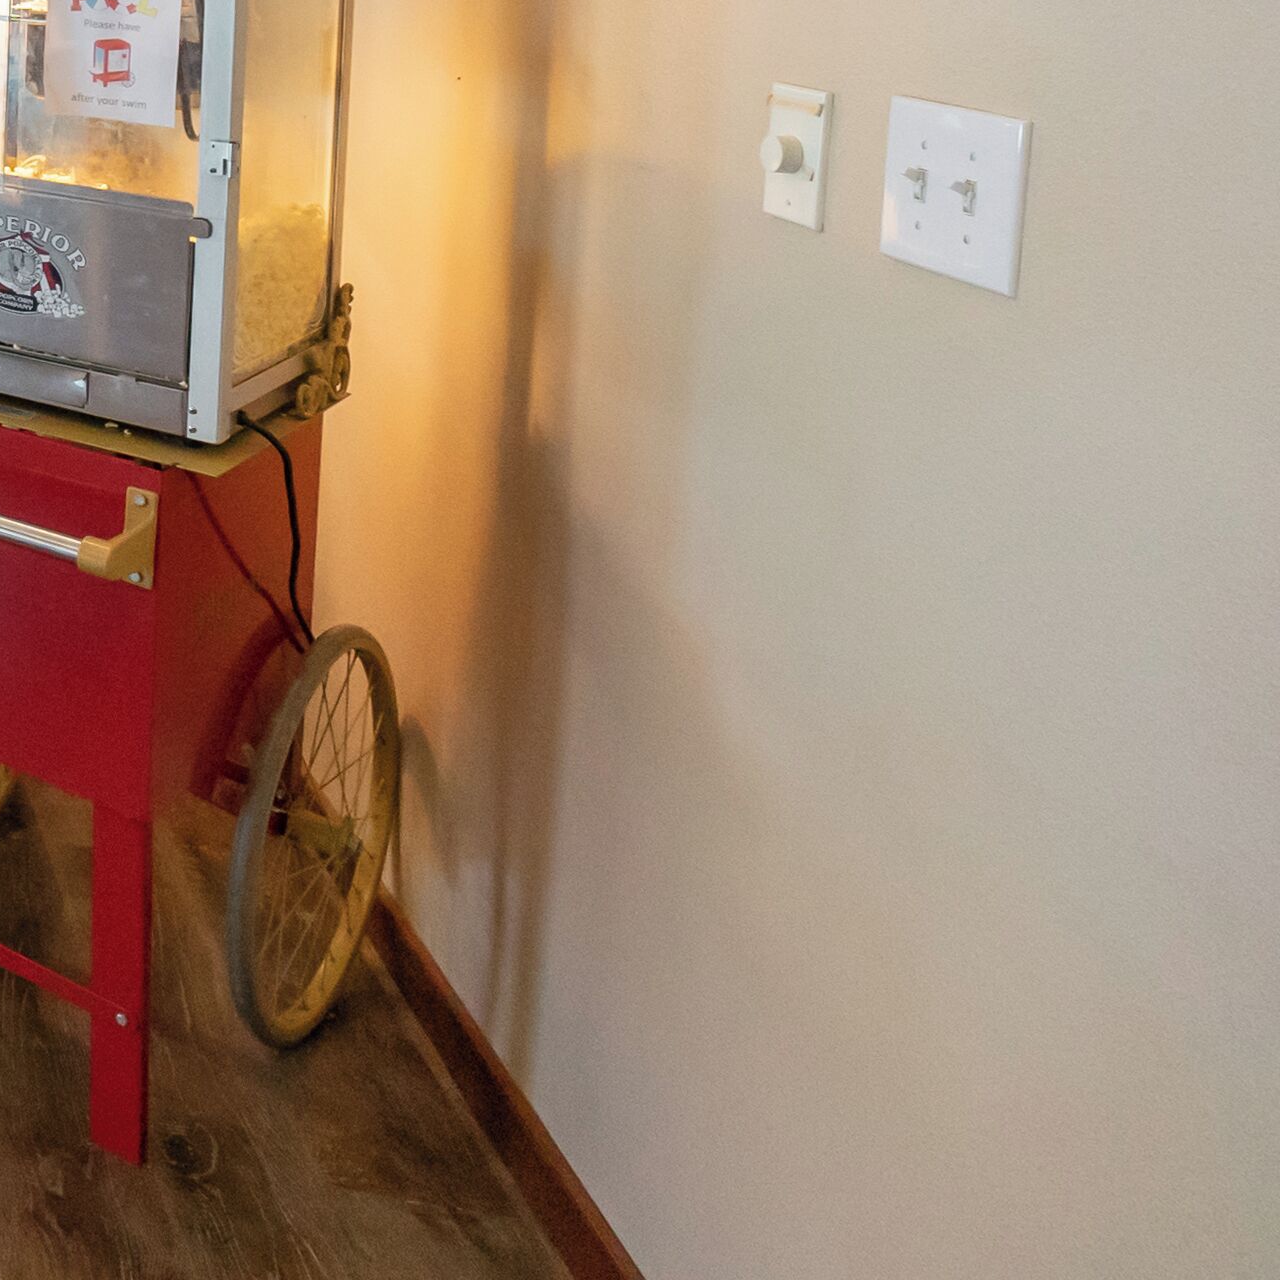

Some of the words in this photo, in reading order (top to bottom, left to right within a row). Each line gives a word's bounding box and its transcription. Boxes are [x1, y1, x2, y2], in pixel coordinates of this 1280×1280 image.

[84, 19, 116, 30] Please
[117, 20, 141, 32] have
[71, 91, 94, 103] after
[96, 96, 118, 108] your
[121, 97, 147, 109] swim
